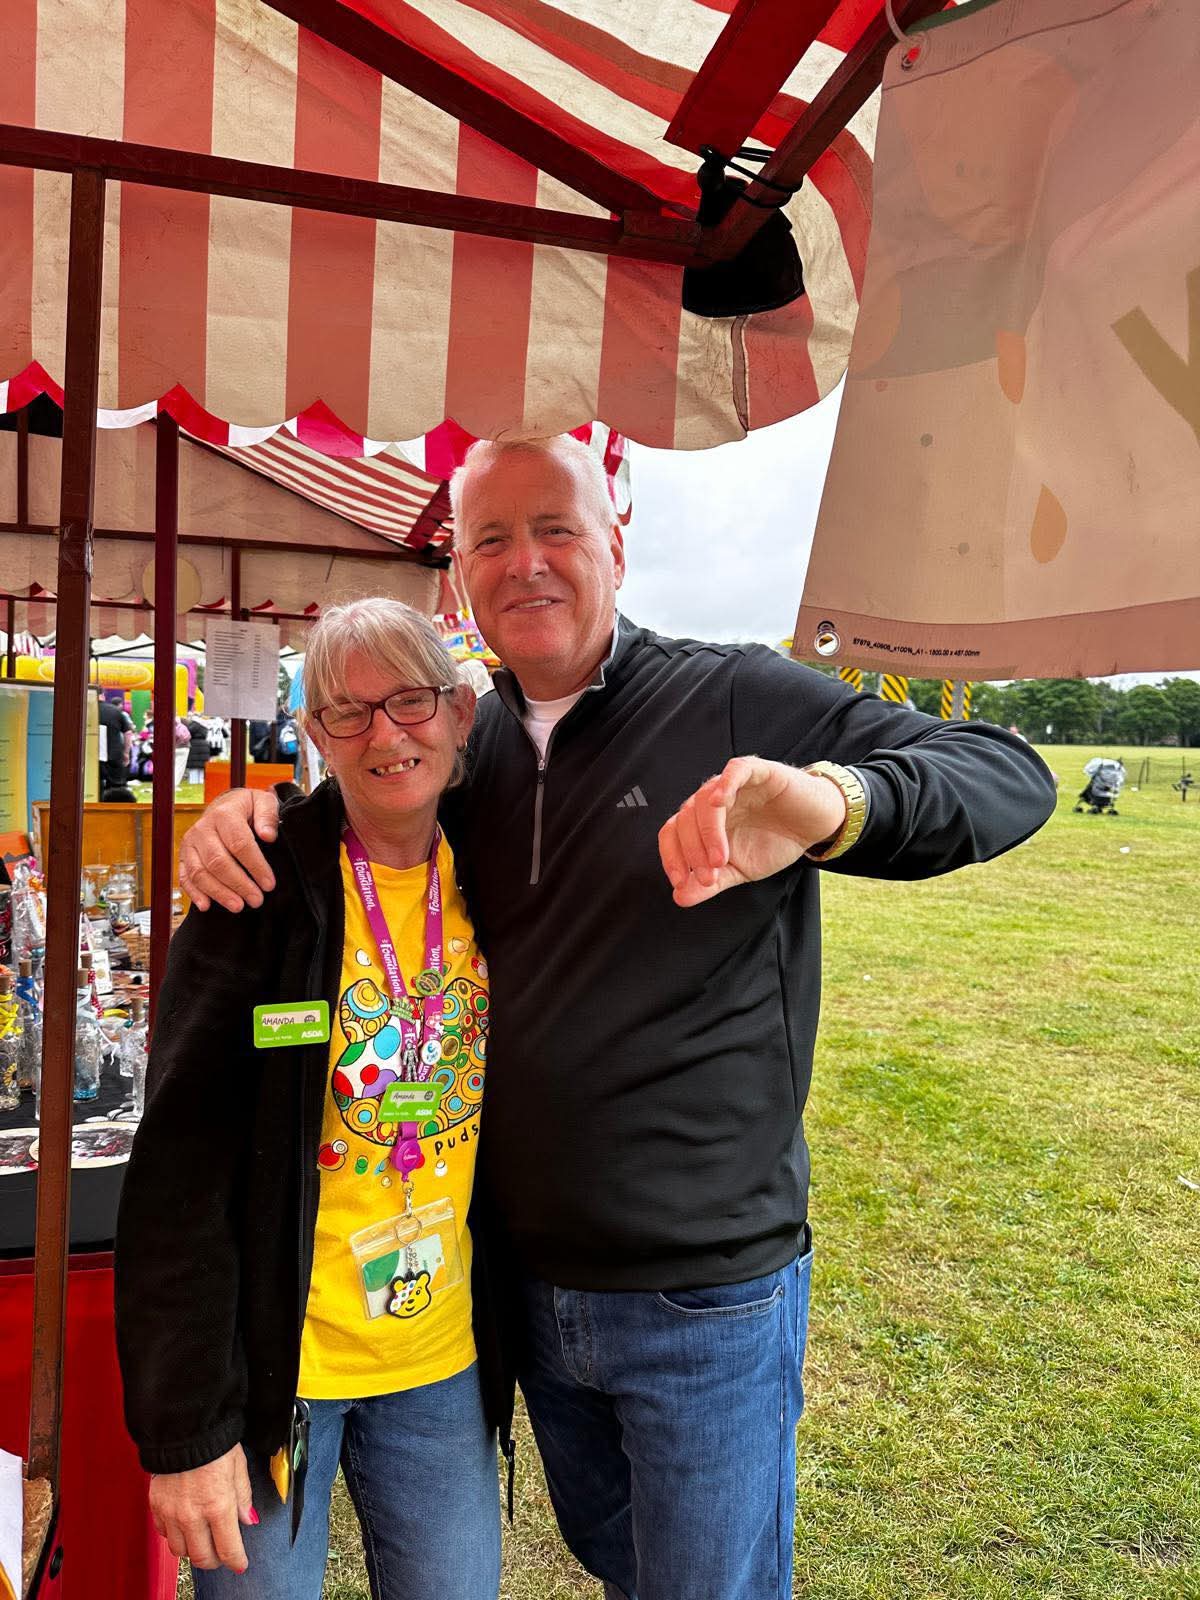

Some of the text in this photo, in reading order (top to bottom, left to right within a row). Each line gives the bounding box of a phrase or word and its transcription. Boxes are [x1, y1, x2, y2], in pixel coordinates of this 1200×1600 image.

[353, 860, 376, 909] Foundation
[428, 866, 440, 912] Foundation
[379, 943, 402, 993] Foundation
[262, 1017, 295, 1026] AMANDA
[301, 1030, 324, 1039] ASDA
